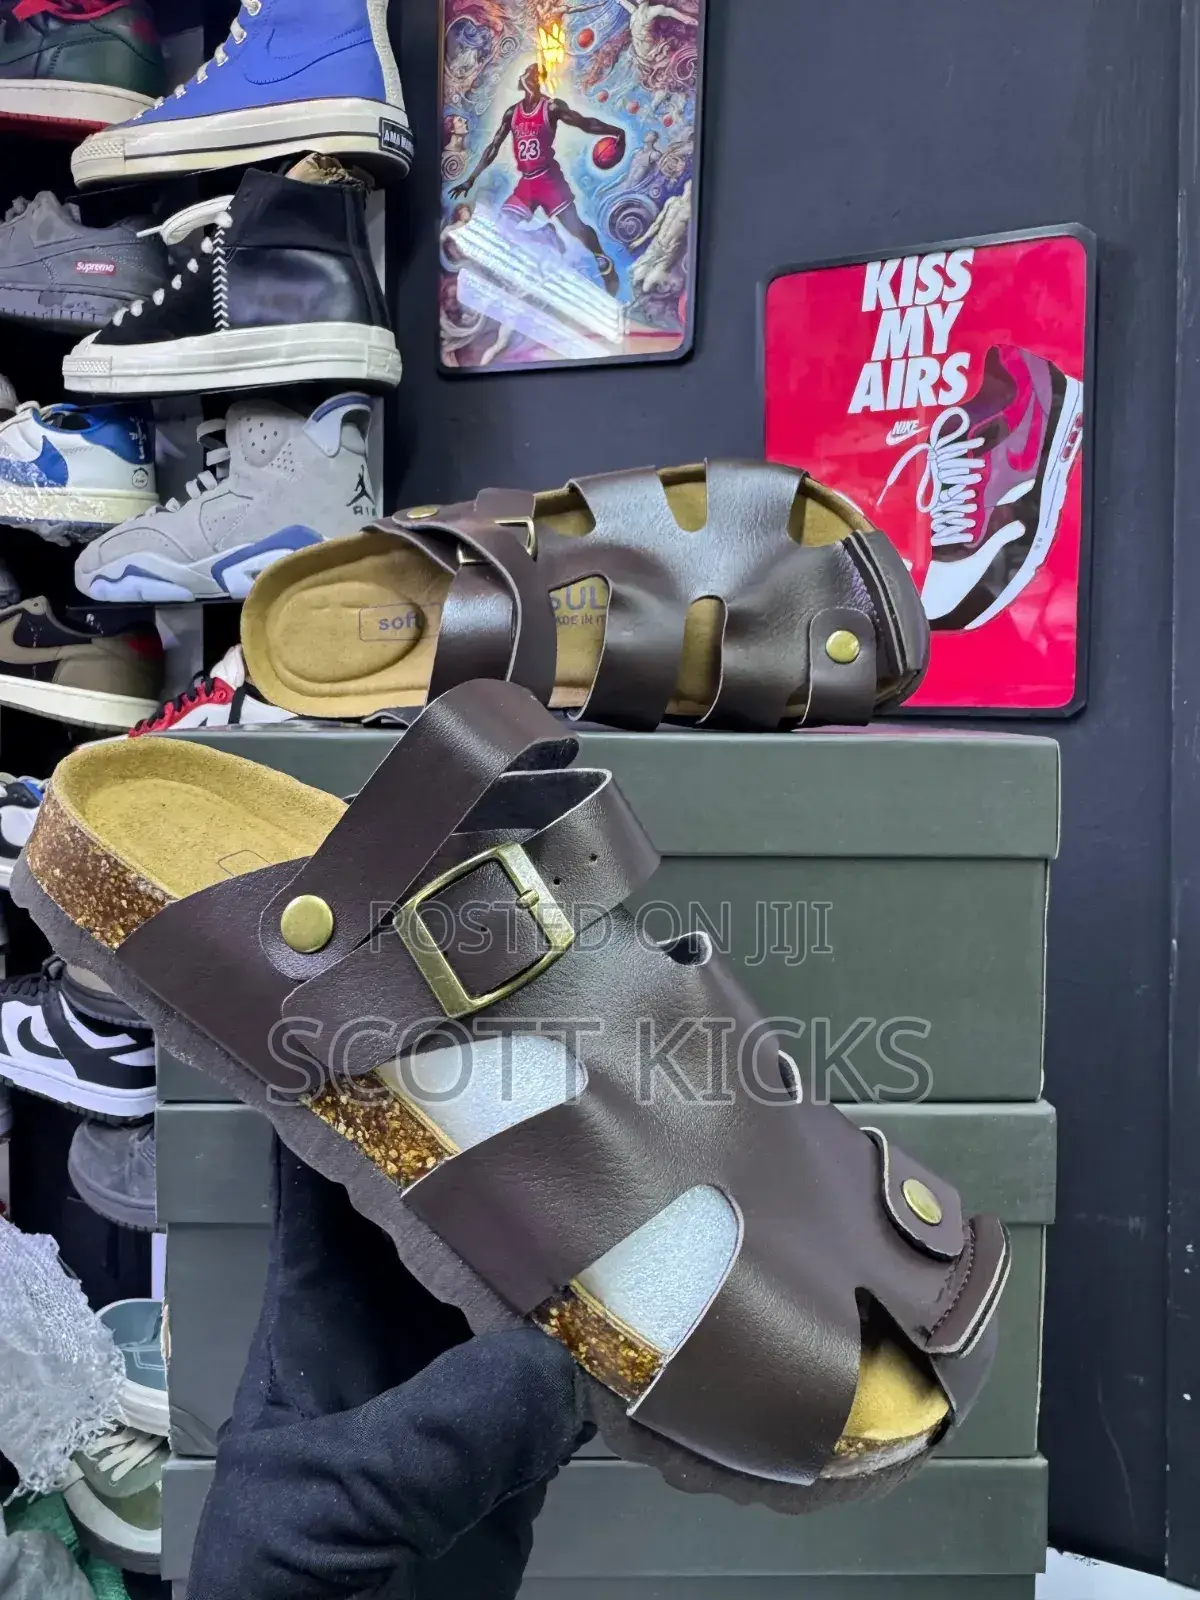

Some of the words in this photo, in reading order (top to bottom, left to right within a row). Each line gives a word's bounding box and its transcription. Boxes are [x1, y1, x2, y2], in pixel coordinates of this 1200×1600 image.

[518, 138, 540, 161] 23
[76, 261, 115, 273] Supreme
[861, 248, 974, 312] KISS
[871, 301, 964, 361] MY
[848, 352, 971, 414] AIRS
[891, 420, 920, 435] NIKE
